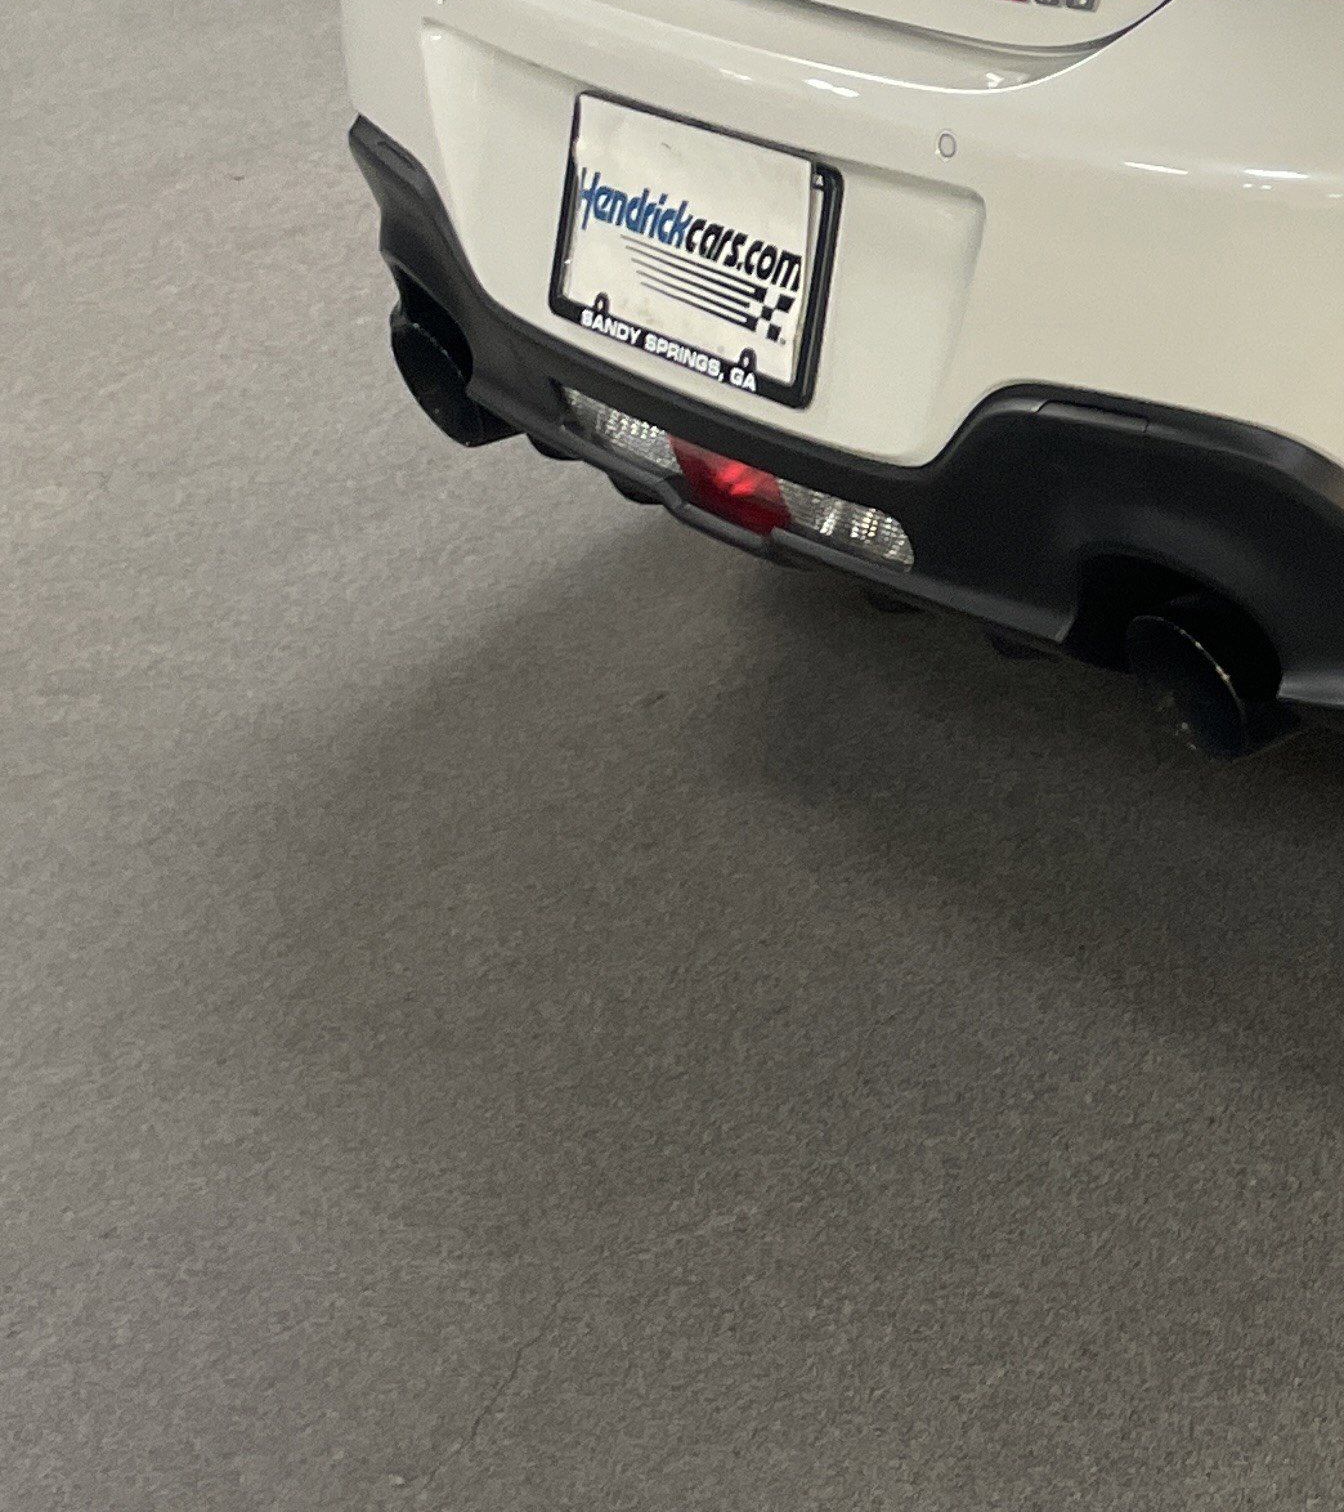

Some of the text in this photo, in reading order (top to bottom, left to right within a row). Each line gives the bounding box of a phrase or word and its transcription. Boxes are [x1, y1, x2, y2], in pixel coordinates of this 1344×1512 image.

[580, 167, 802, 292] Hendrickcars.com
[581, 309, 757, 393] SANDY SPRINGS, GA
